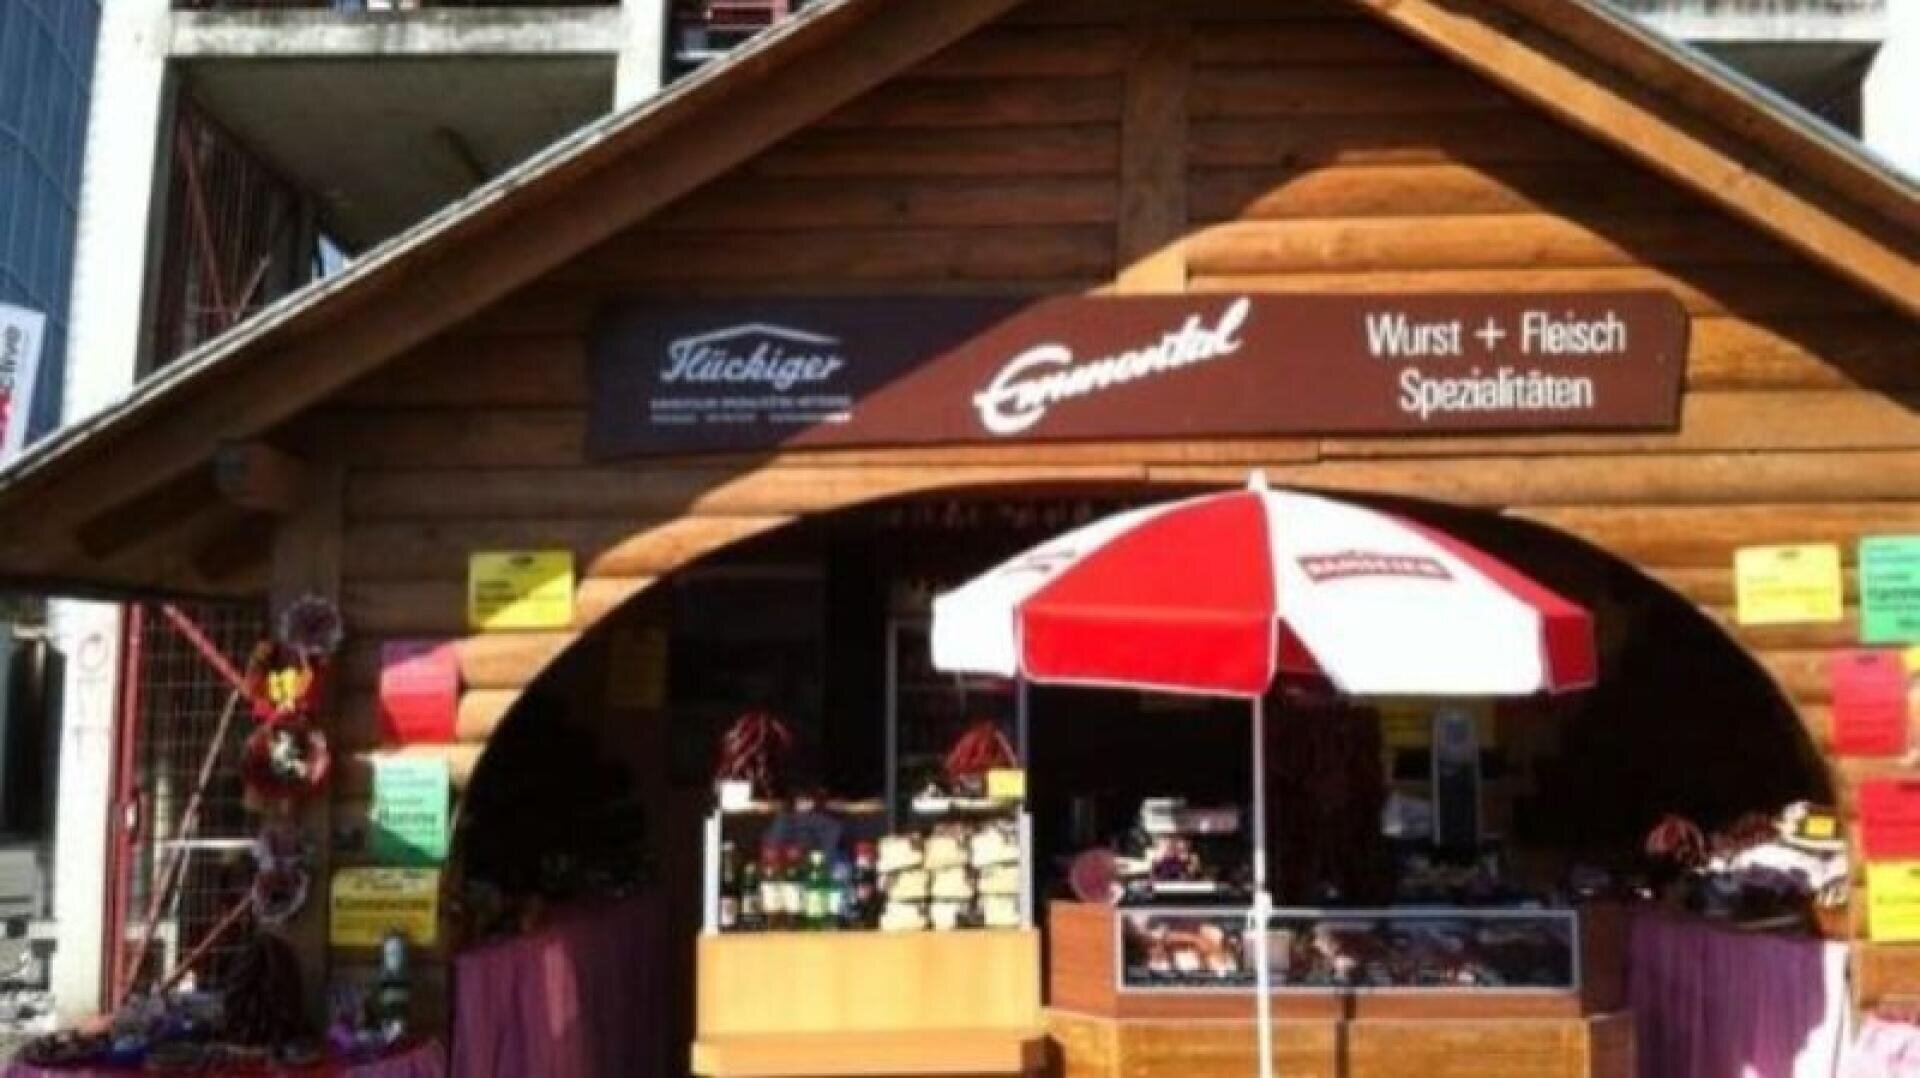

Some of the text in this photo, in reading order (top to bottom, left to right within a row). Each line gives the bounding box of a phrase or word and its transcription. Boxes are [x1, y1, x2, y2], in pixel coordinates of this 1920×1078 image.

[1366, 308, 1627, 356] Wurst + Fleisch
[1398, 366, 1594, 418] Spezialitäten
